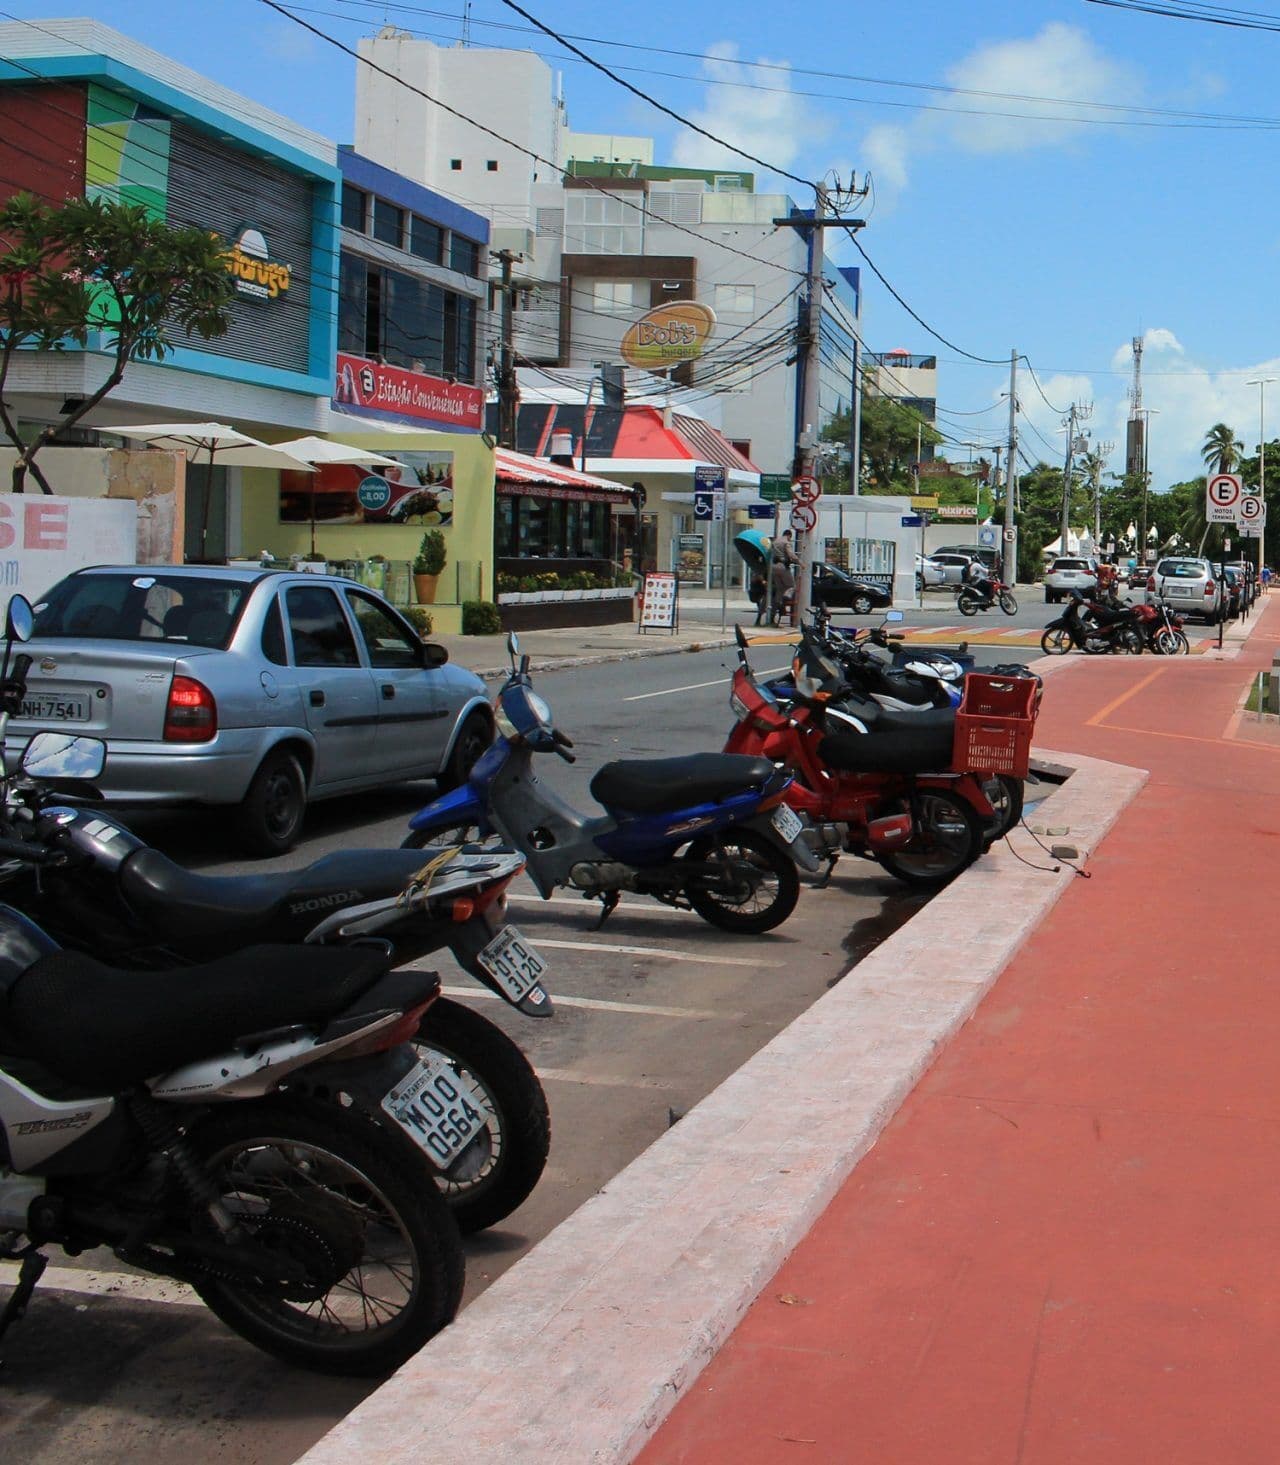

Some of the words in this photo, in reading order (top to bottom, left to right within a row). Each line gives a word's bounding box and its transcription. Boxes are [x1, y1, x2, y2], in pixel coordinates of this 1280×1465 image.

[638, 320, 696, 346] Bob's
[378, 376, 411, 407] Estação
[413, 384, 464, 416] Conveniência
[1219, 483, 1229, 499] E
[1246, 502, 1253, 513] E
[1007, 531, 1013, 539] E
[19, 701, 82, 718] NH-7541
[289, 888, 365, 914] HONDA
[508, 957, 542, 994] 3120
[427, 1098, 480, 1159] 0564
